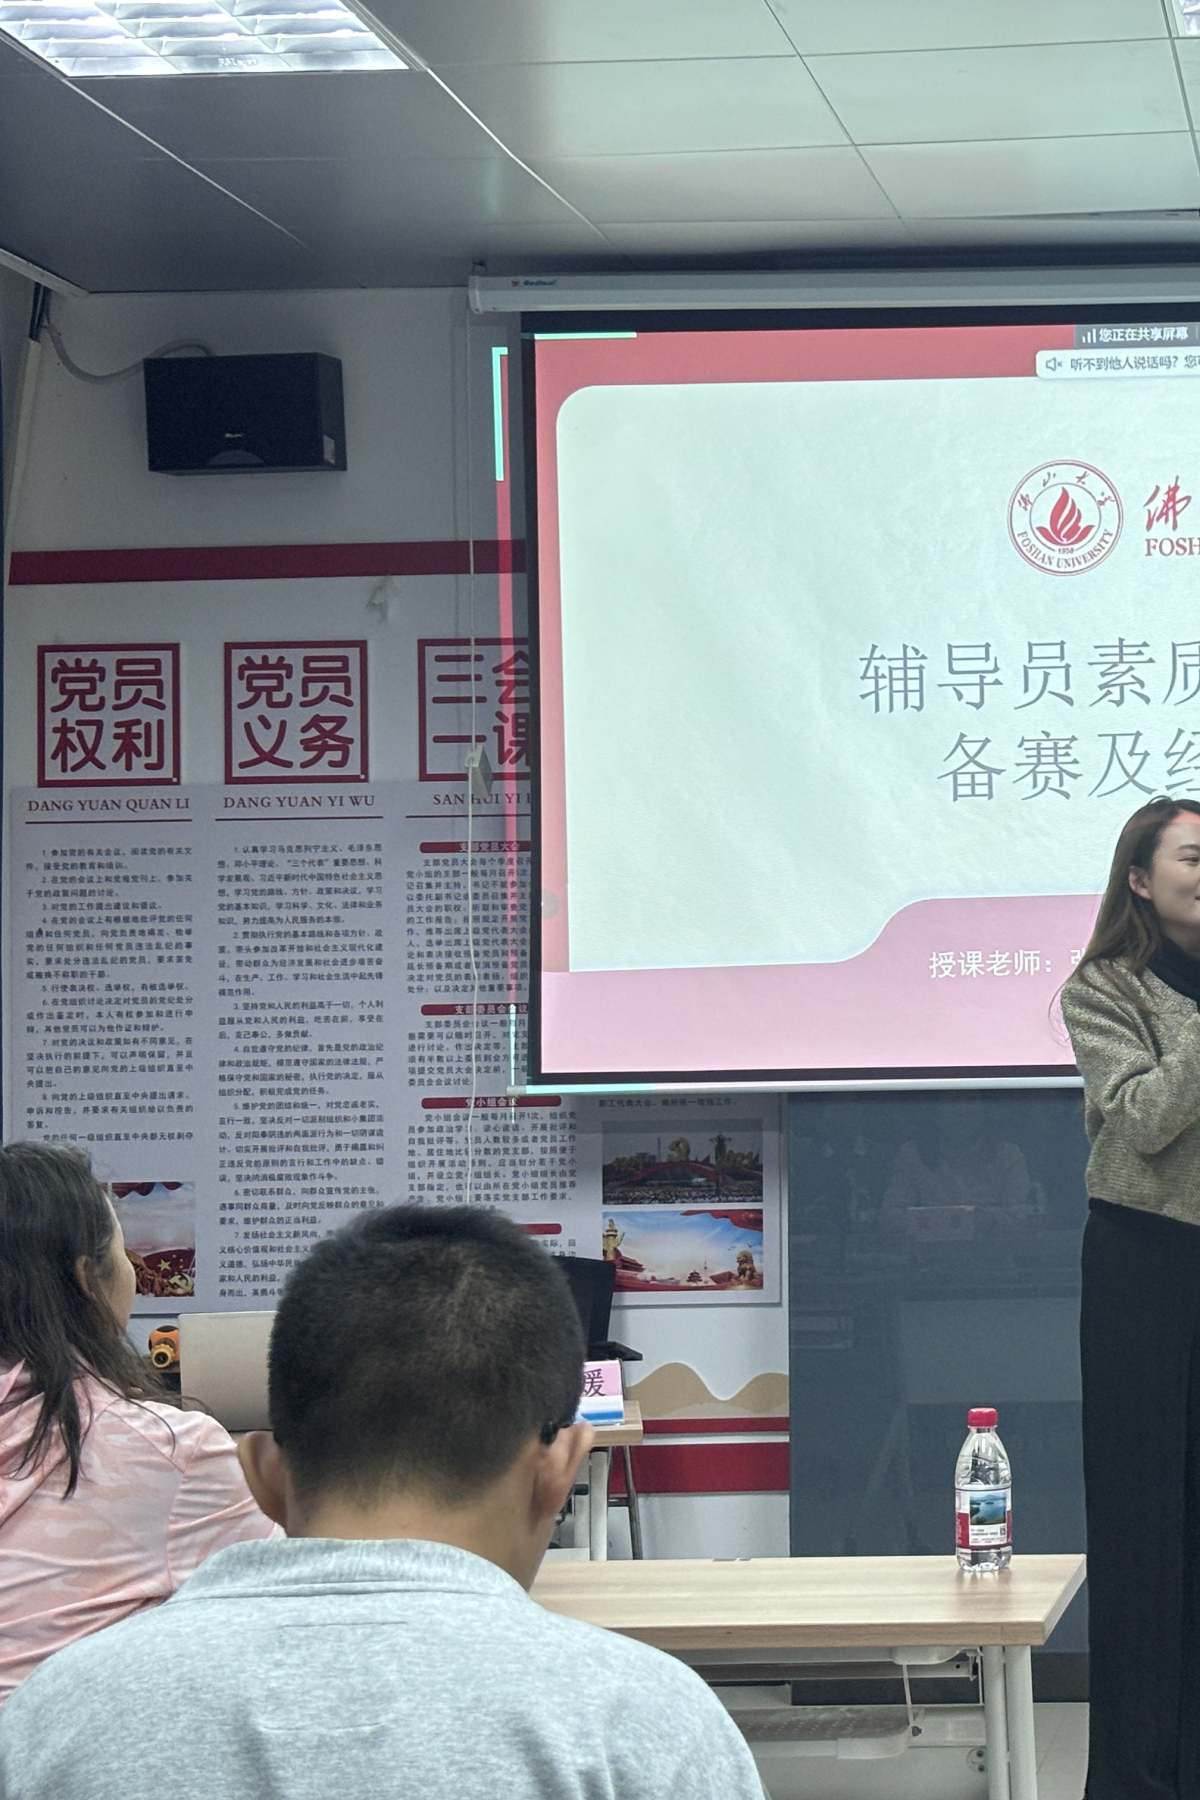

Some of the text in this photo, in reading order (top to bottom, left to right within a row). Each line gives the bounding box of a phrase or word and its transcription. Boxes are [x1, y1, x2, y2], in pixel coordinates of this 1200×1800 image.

[1099, 326, 1189, 343] 您正在共享屏幕
[1017, 529, 1113, 569] FOSHAN UNIVERSITY
[51, 657, 167, 713] 党员
[237, 654, 355, 710] 党员
[51, 717, 167, 774] 权利
[237, 714, 355, 770] 义务
[28, 798, 190, 812] DANG YUAN QUAN LI
[224, 795, 375, 809] DANG YUAN YI WU
[433, 793, 464, 805] SAN
[504, 793, 519, 804] YI
